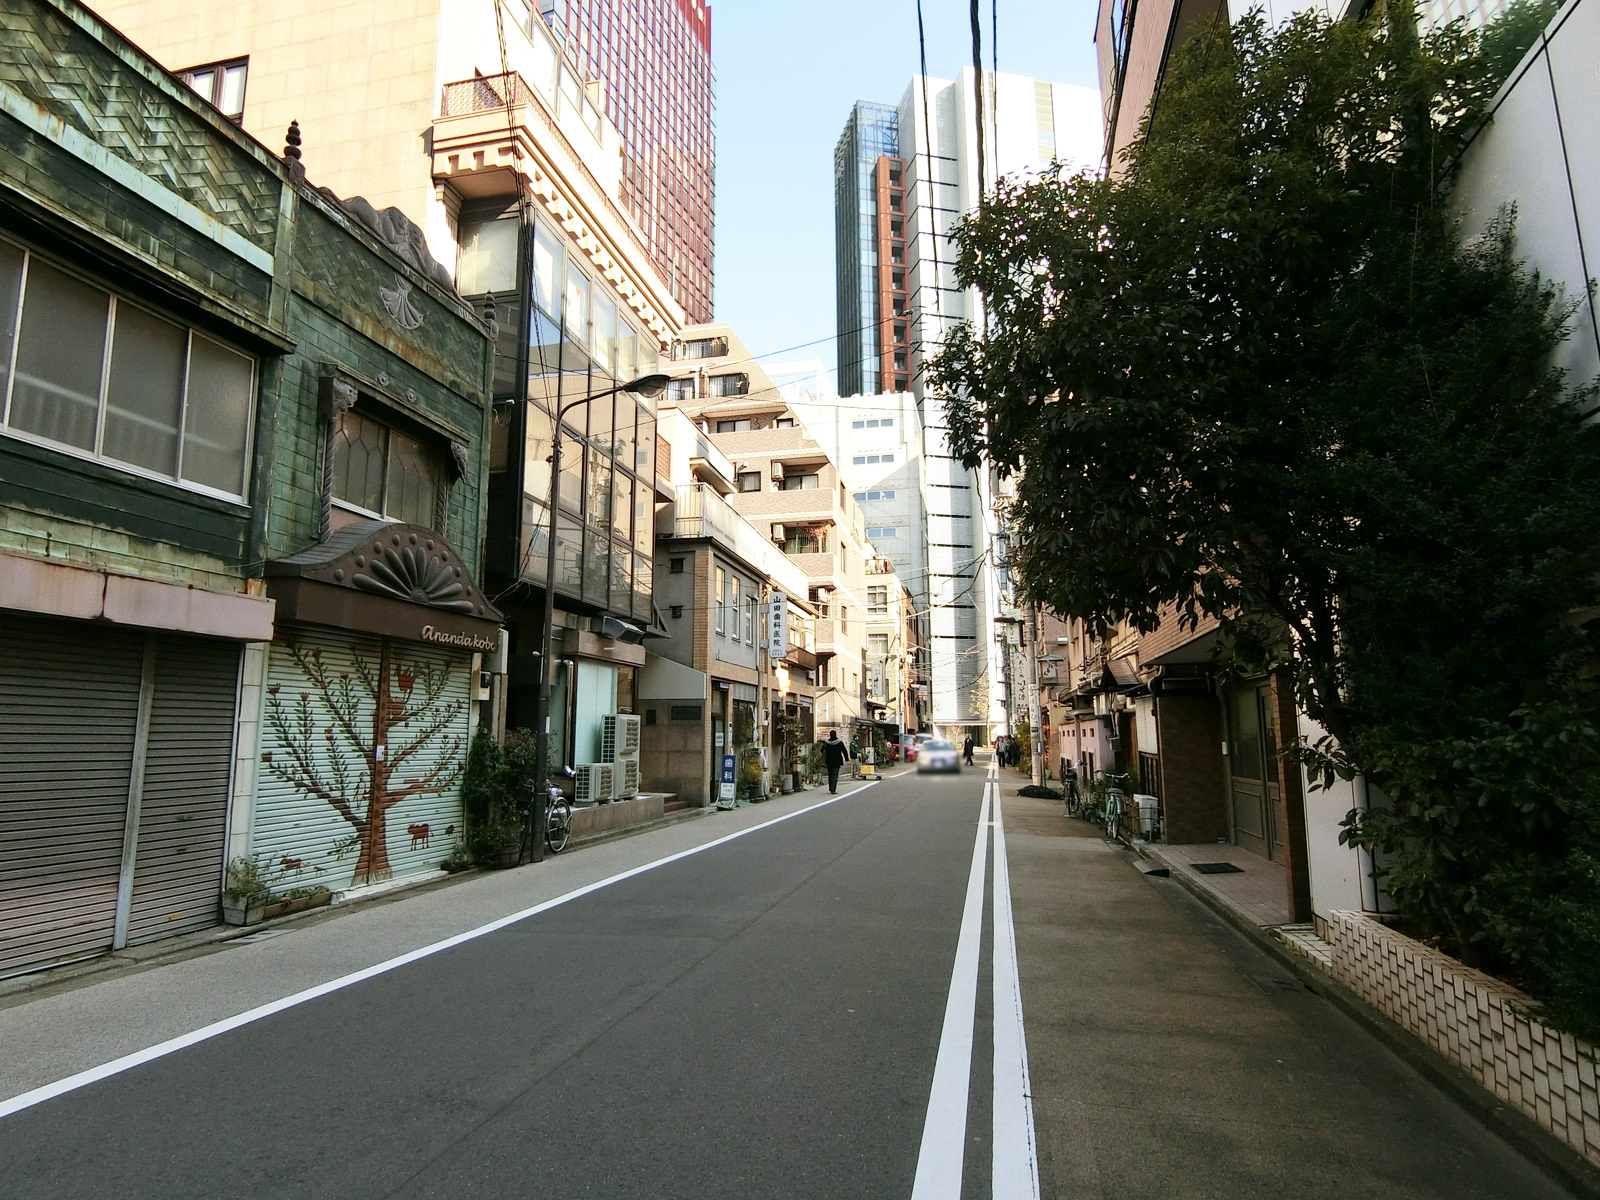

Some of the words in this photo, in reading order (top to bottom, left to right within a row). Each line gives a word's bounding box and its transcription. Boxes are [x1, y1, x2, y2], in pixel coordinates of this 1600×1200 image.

[773, 595, 781, 647] 山田歯科医院
[723, 758, 733, 781] 歯科
